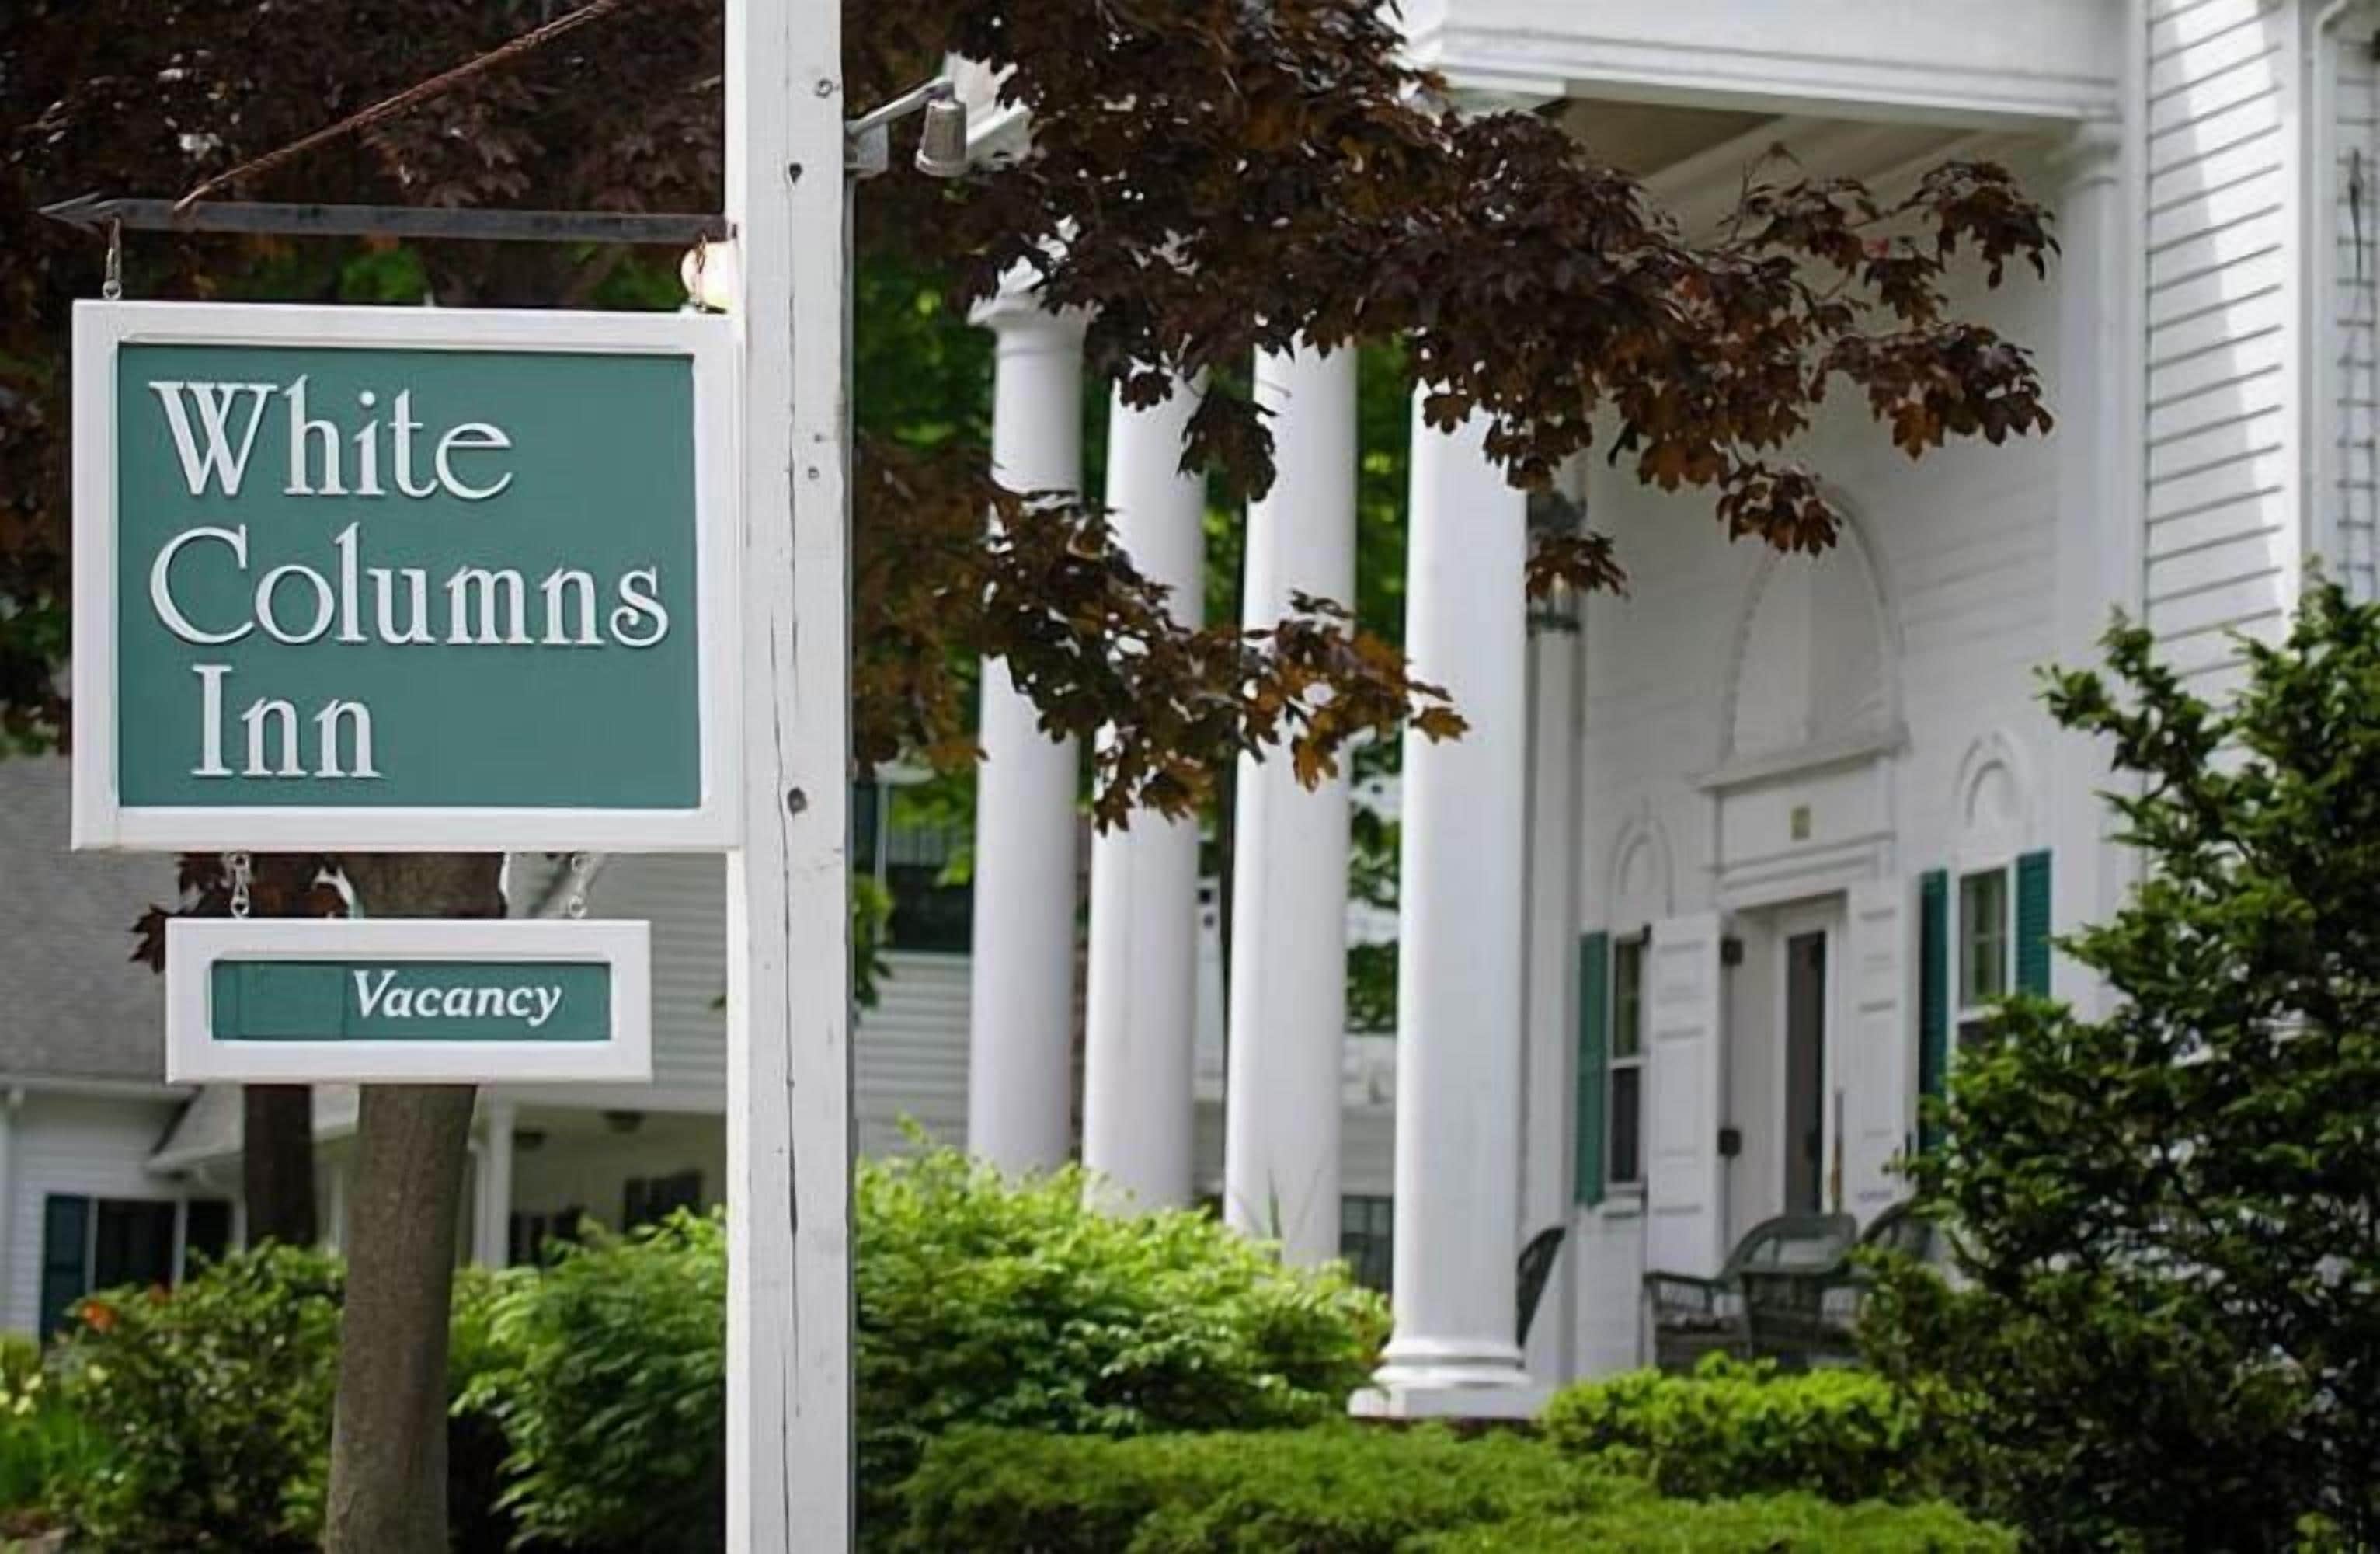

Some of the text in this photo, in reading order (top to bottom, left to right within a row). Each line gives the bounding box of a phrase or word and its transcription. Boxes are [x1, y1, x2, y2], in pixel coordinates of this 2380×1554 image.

[148, 375, 513, 499] White
[150, 521, 669, 646] Columns
[191, 664, 381, 779] Inn
[353, 969, 562, 1027] Vacancy
